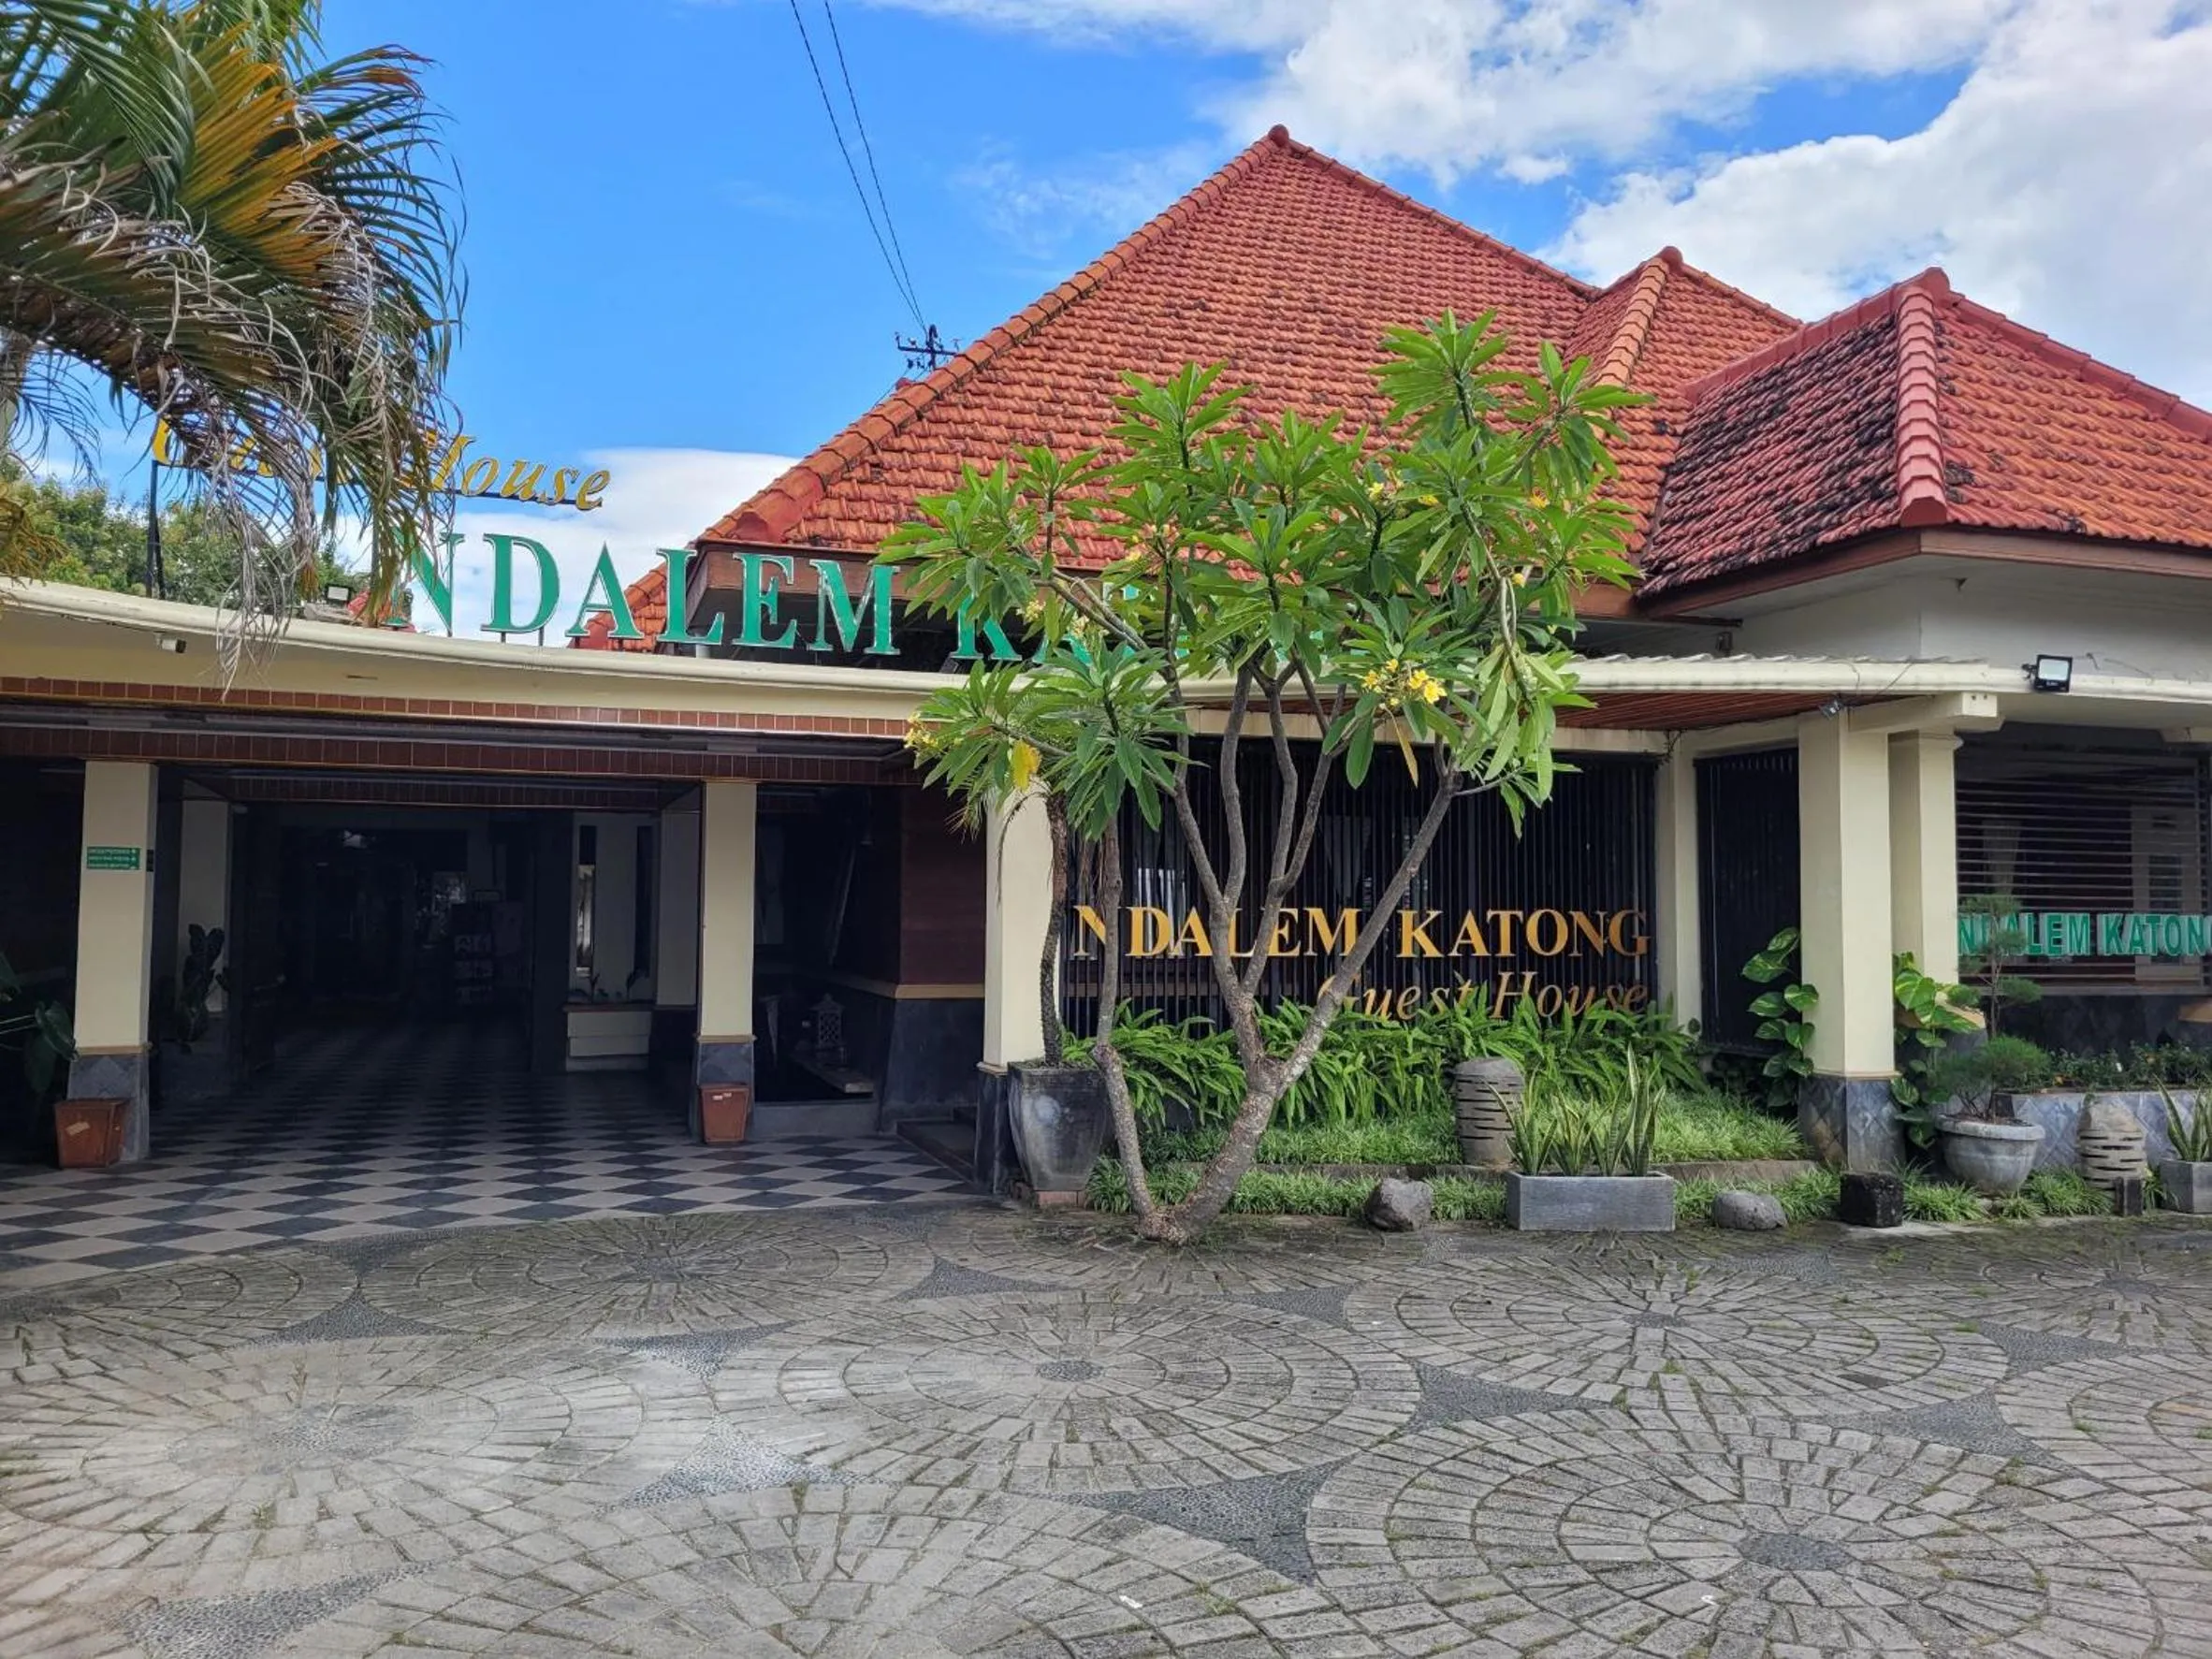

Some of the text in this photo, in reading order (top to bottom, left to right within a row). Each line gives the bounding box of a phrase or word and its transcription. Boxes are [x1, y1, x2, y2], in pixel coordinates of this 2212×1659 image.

[381, 524, 901, 658] NDALEM
[1072, 904, 1651, 959] NDALEM KATONG
[2097, 913, 2212, 957] KATON
[1490, 970, 1649, 1019] House
